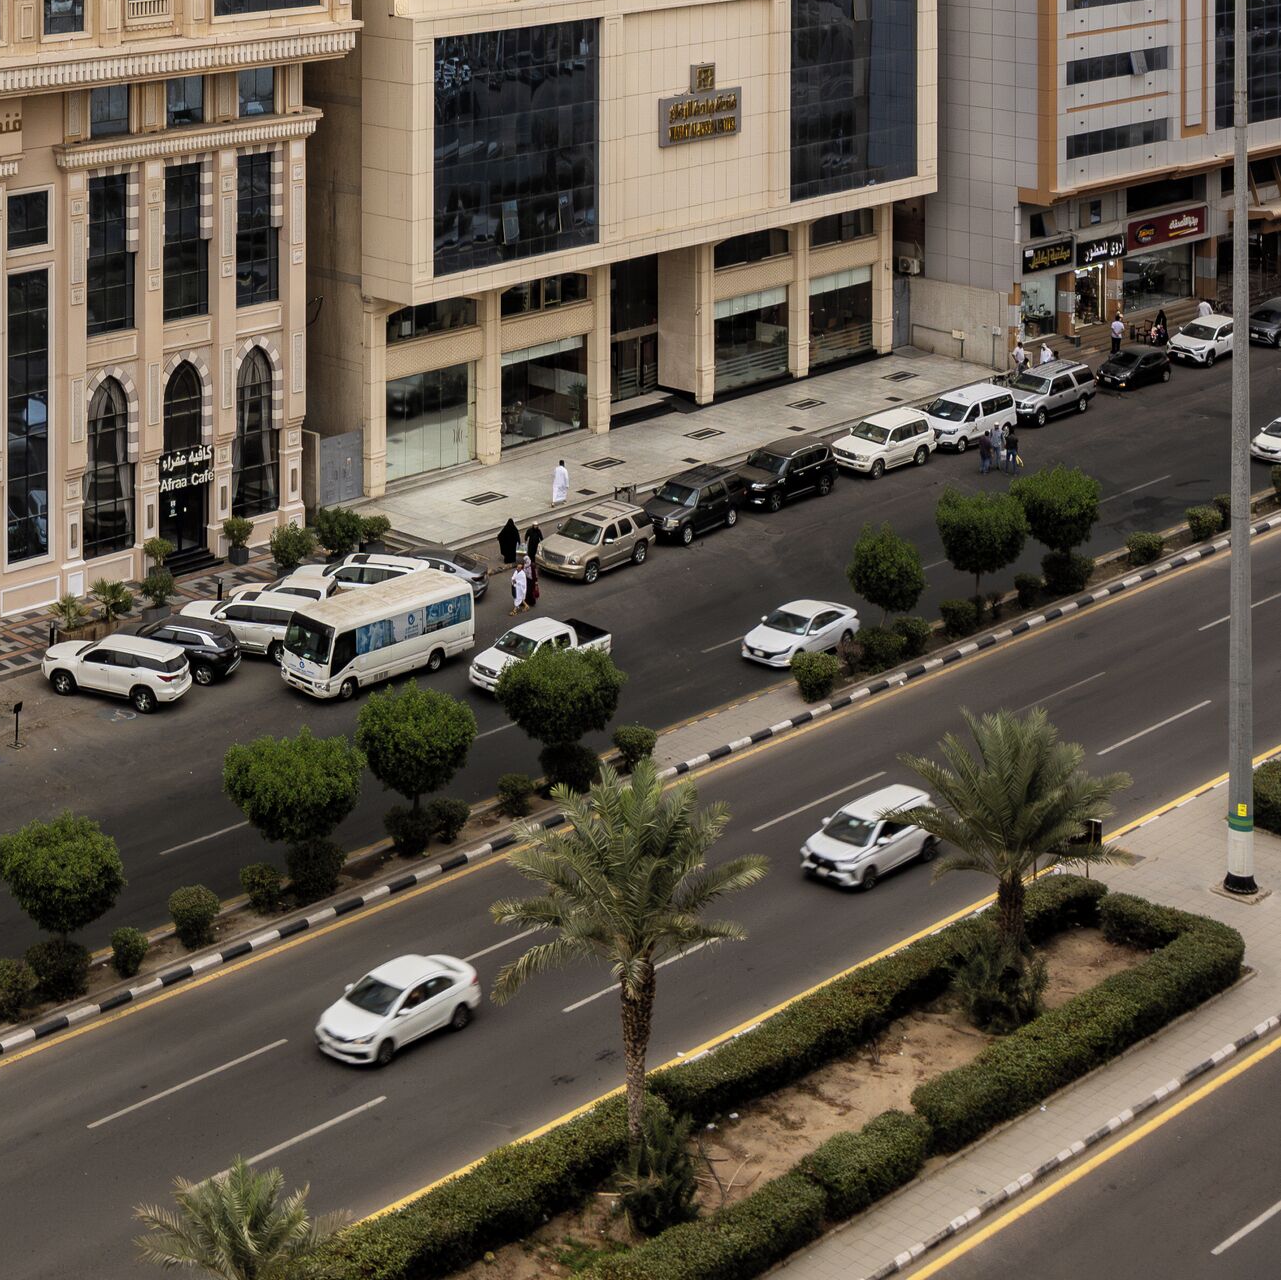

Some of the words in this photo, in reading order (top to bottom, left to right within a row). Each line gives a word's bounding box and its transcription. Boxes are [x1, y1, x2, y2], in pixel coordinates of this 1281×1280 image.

[1085, 241, 1108, 262] للعطور
[162, 452, 187, 472] عفراء
[188, 445, 213, 466] كافيه
[159, 477, 187, 493] Afraa
